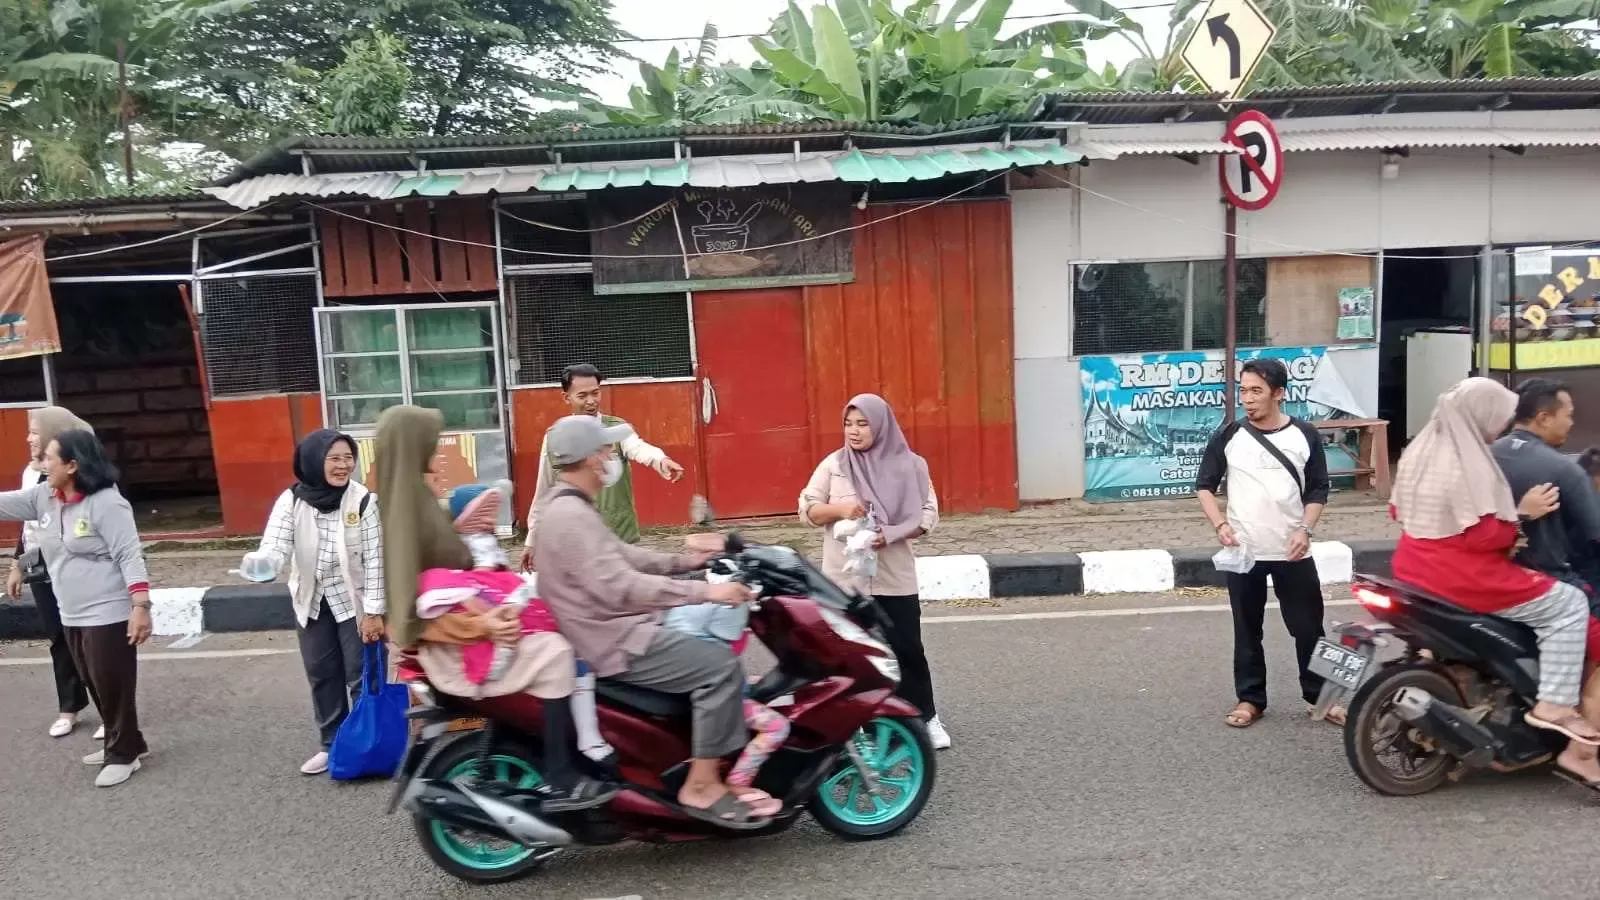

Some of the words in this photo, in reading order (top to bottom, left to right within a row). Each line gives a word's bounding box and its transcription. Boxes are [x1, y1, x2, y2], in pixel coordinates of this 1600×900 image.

[705, 240, 737, 252] SOUP
[1119, 363, 1171, 389] RM
[1131, 388, 1227, 411] MASAKAN
[1132, 487, 1160, 497] 0818
